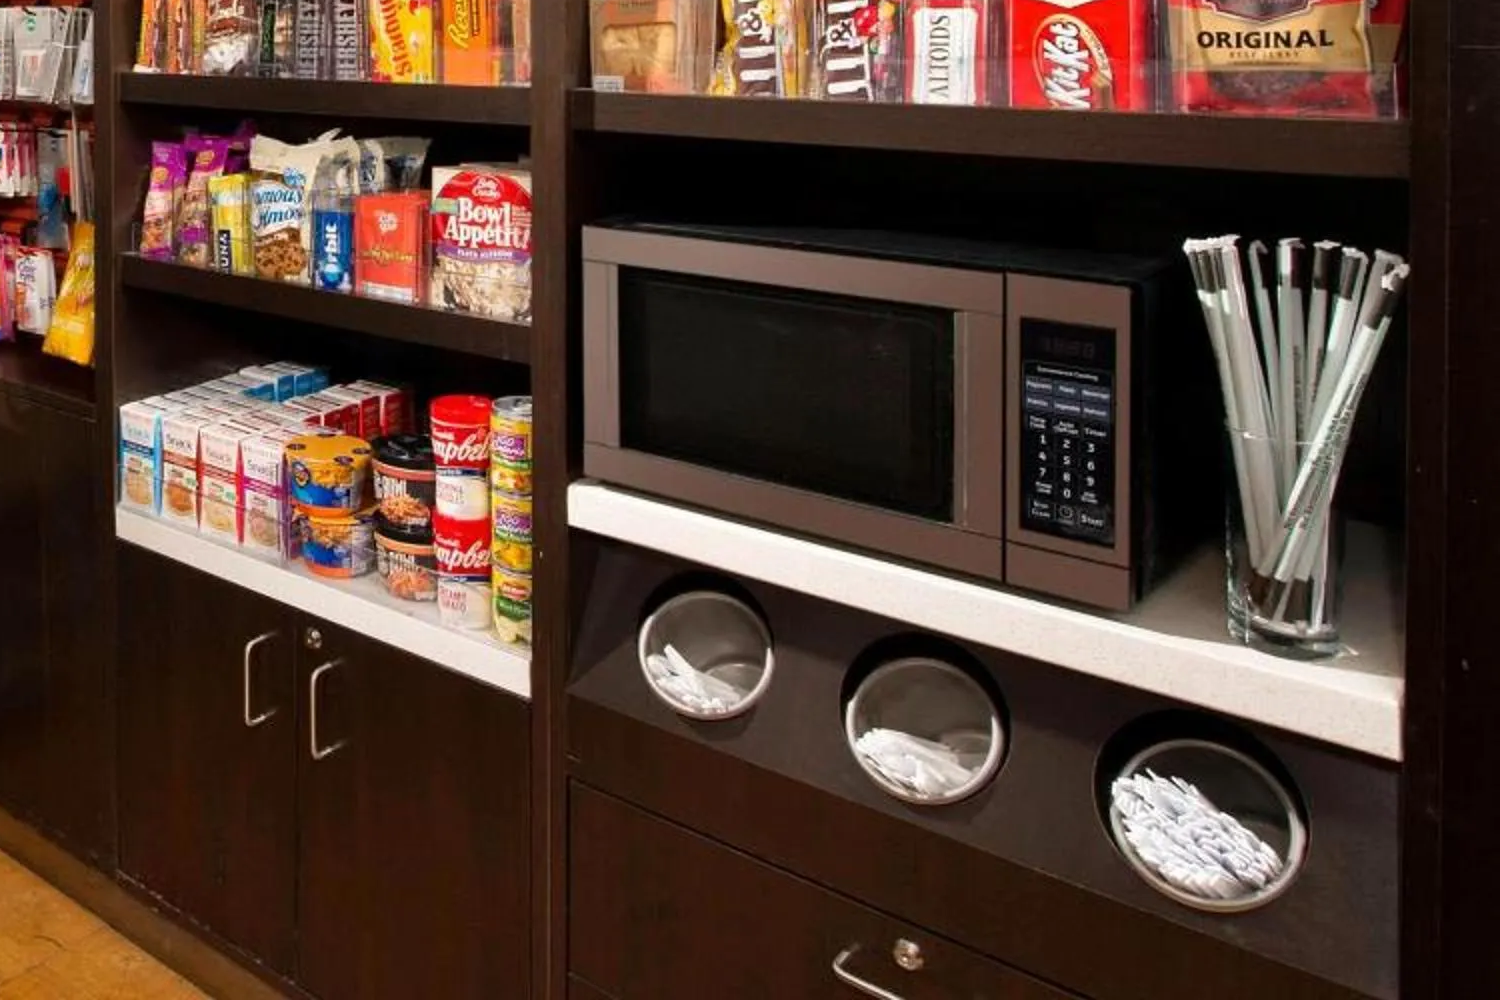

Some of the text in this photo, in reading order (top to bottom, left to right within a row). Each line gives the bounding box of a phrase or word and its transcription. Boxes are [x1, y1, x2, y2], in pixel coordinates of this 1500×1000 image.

[1197, 29, 1335, 49] ORIGINAL
[929, 15, 951, 101] ALTOIDS
[457, 197, 511, 223] Bowl
